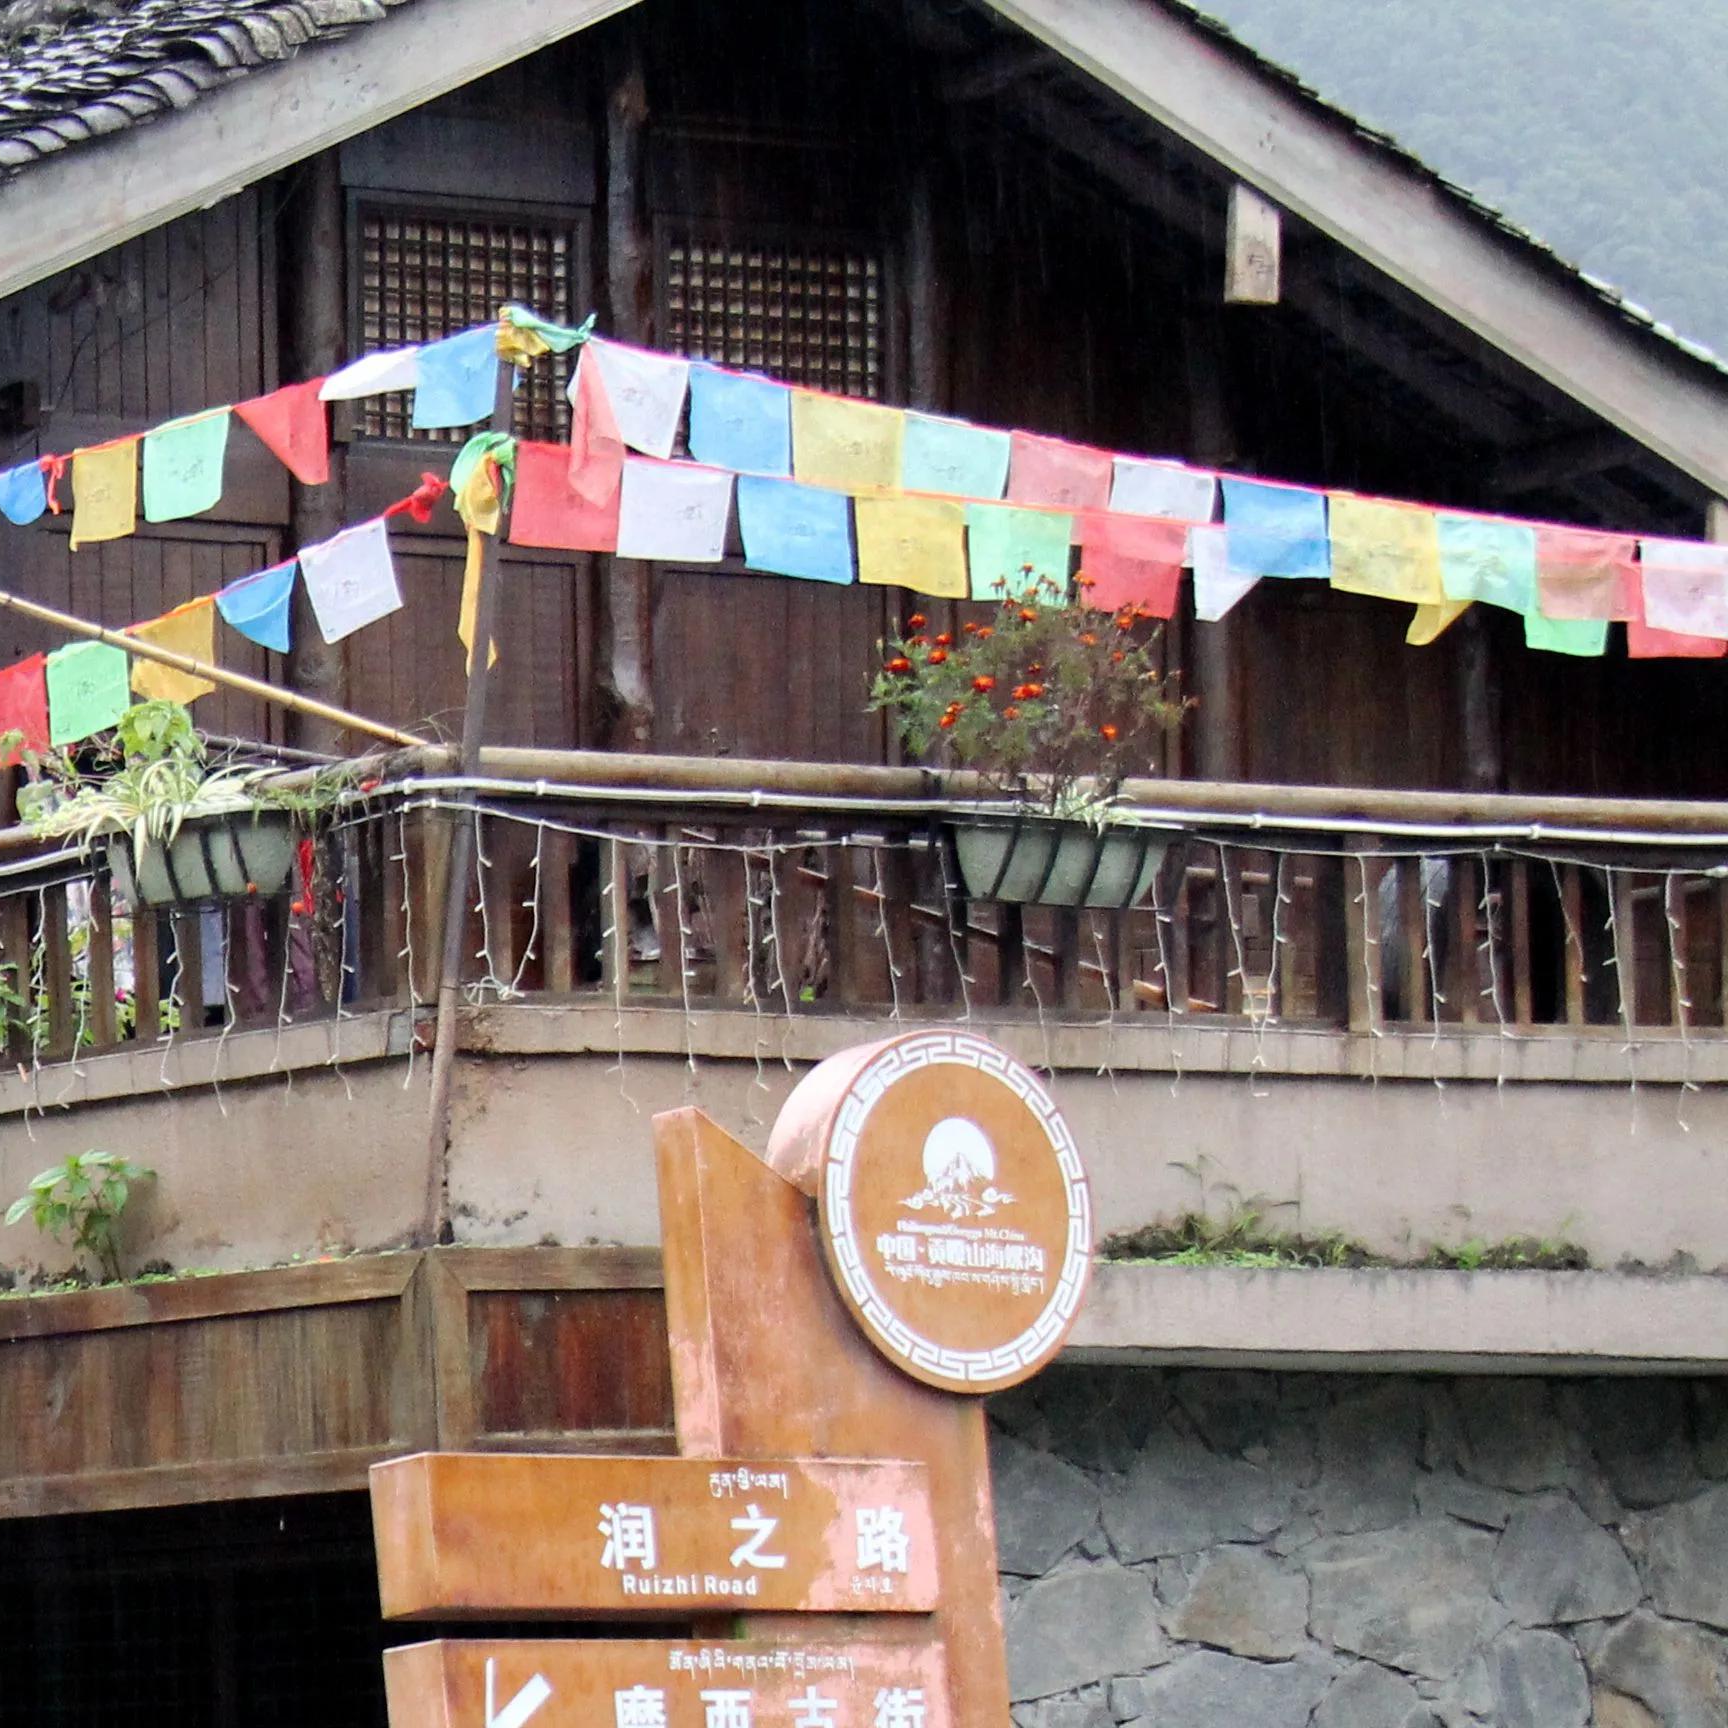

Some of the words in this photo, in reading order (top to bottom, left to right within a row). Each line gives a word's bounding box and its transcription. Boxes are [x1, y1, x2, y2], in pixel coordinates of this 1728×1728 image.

[597, 1502, 910, 1573] 润之路
[622, 1574, 696, 1596] Ruizhi
[704, 1575, 758, 1596] Road
